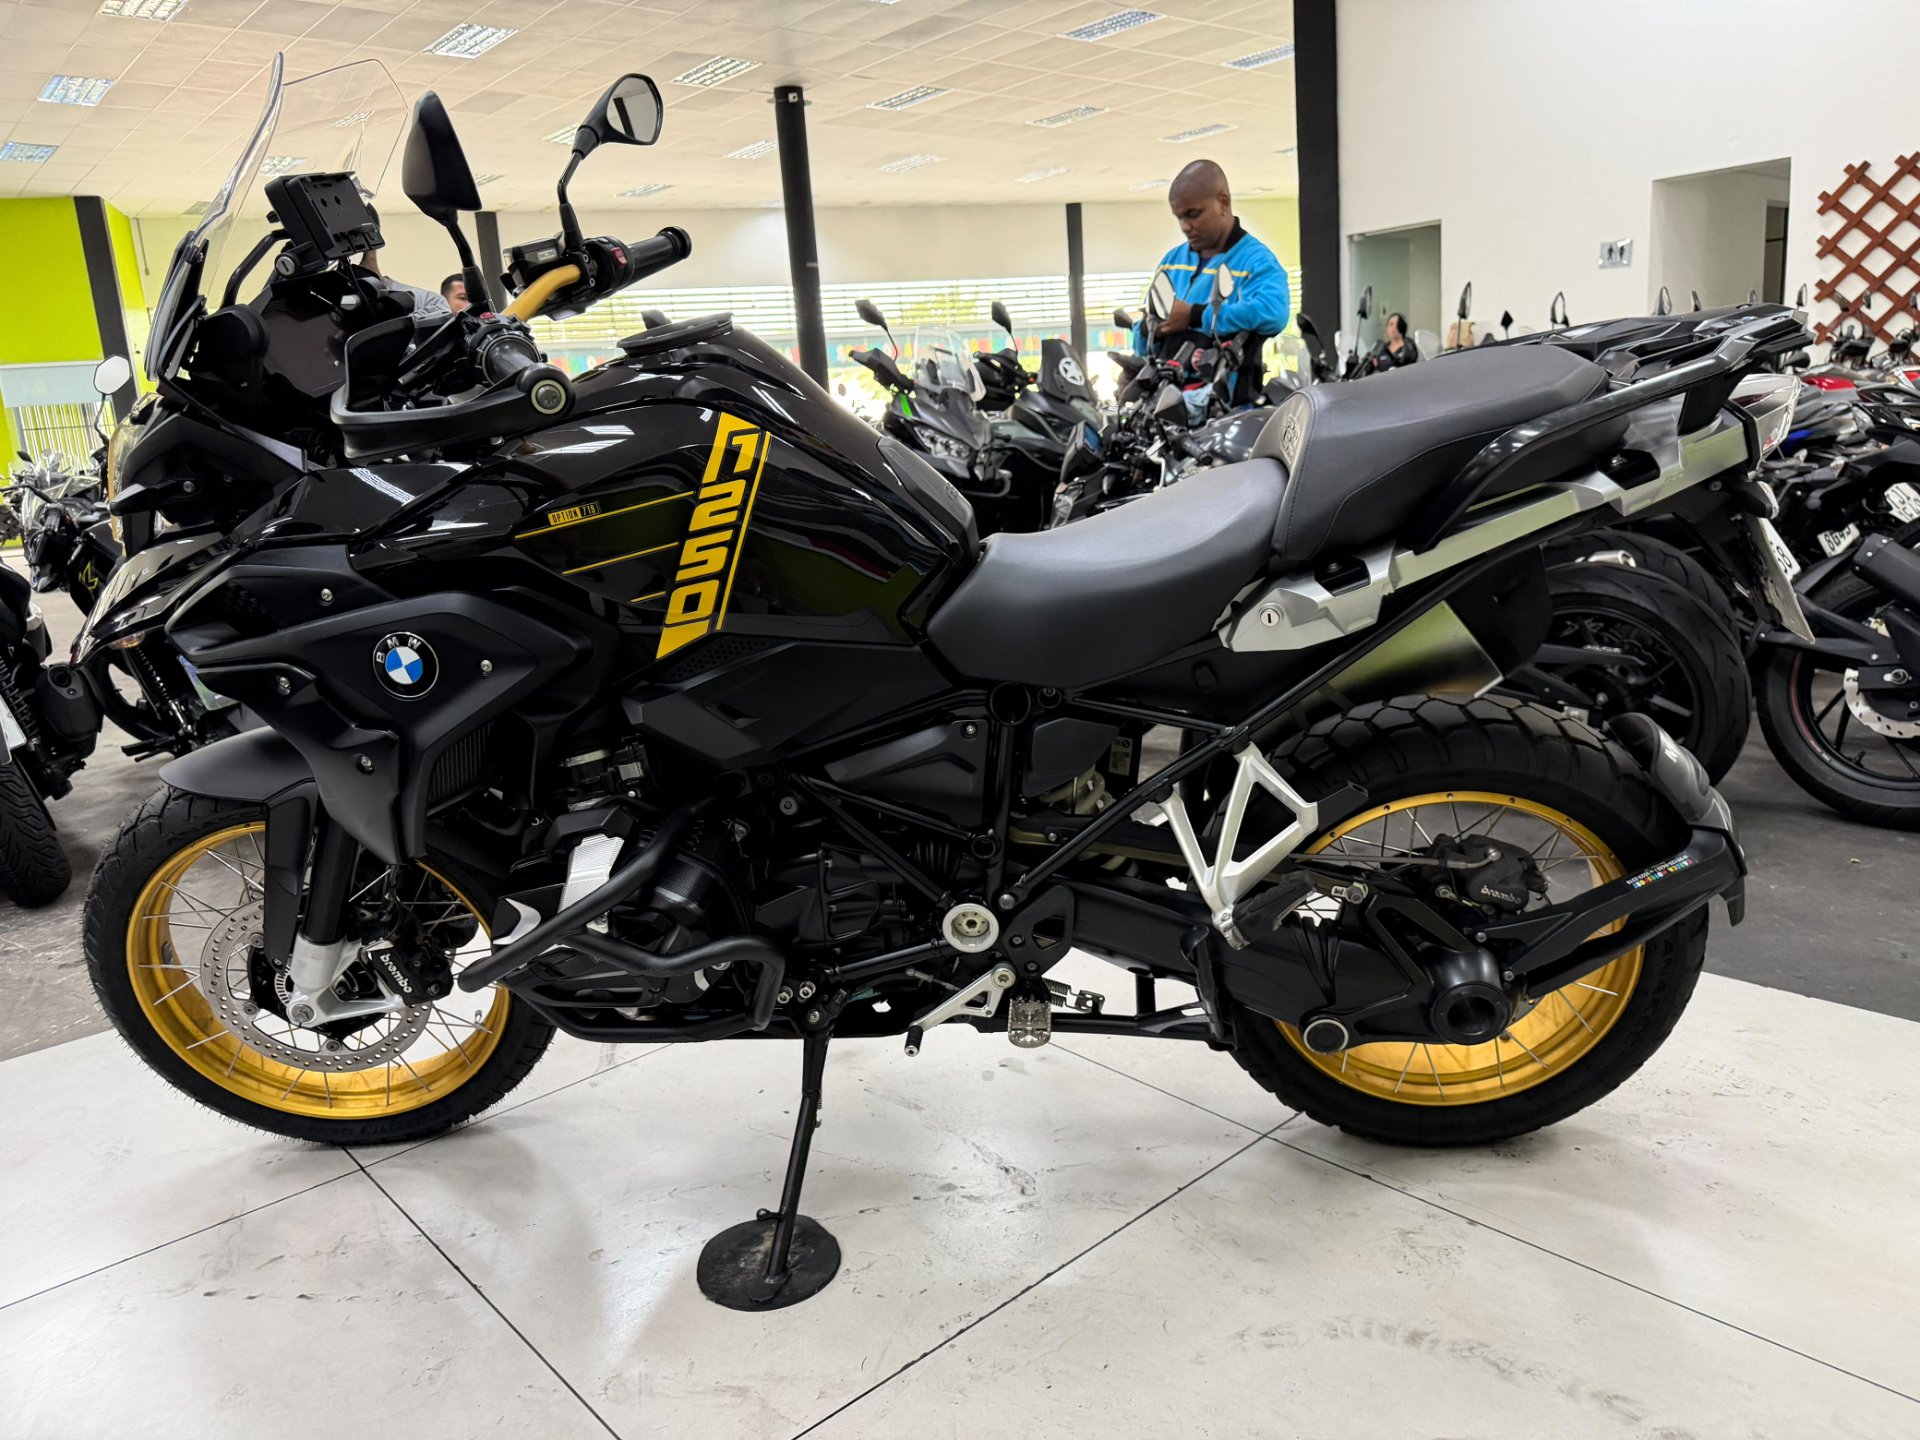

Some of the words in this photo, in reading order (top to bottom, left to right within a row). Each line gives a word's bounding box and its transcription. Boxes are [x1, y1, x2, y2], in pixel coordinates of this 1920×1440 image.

[551, 508, 579, 524] OPTION
[582, 504, 597, 517] 719
[665, 432, 760, 626] 1250
[375, 635, 422, 664] BMW
[1480, 884, 1522, 904] brembo
[379, 953, 413, 993] brembo
